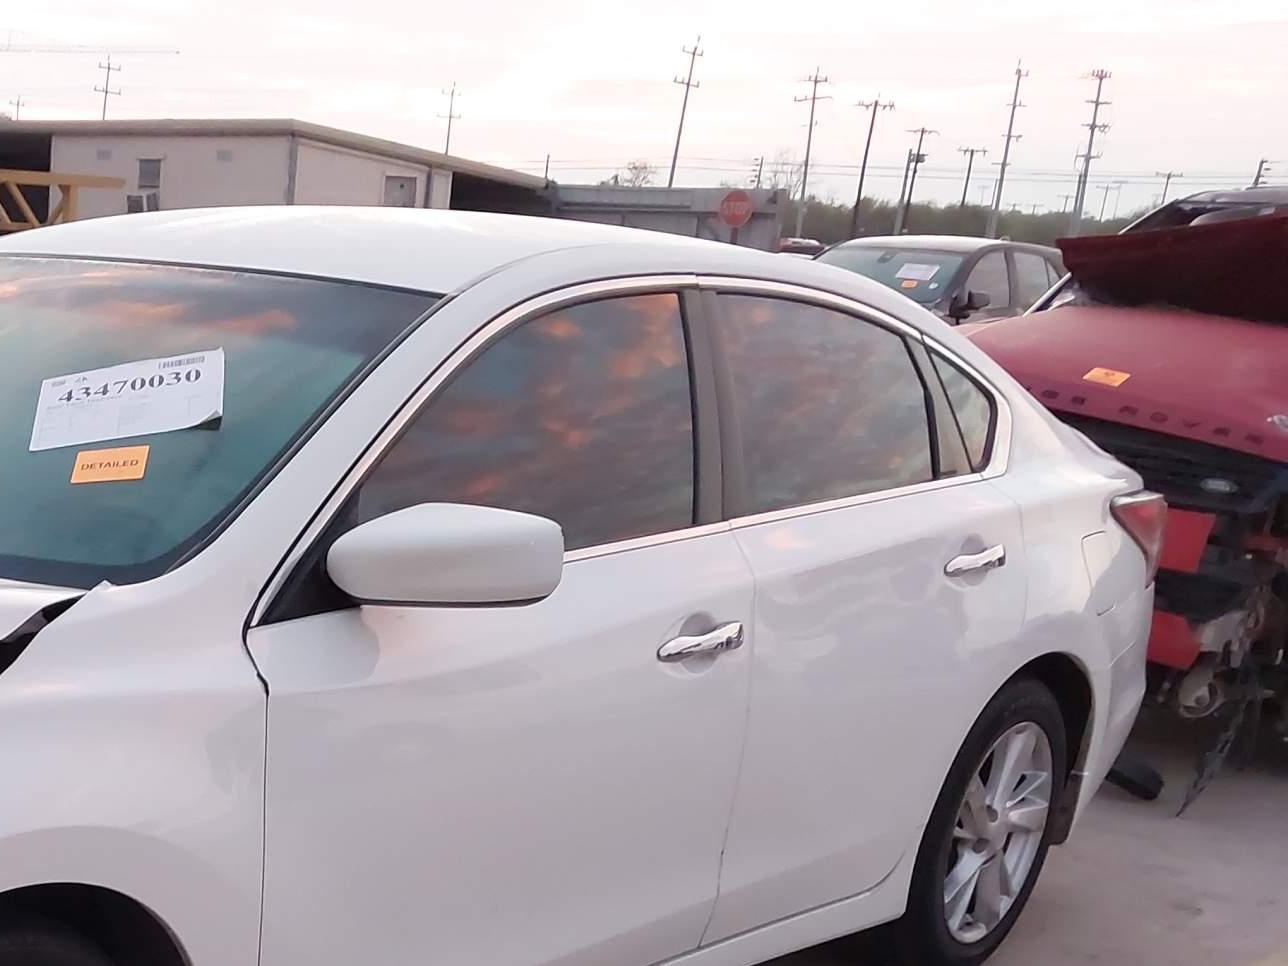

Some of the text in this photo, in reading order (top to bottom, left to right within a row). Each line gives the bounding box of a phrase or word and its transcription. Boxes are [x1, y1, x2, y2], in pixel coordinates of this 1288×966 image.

[723, 201, 749, 216] STOP
[57, 368, 202, 403] 43470030
[80, 459, 139, 471] DETAILED
